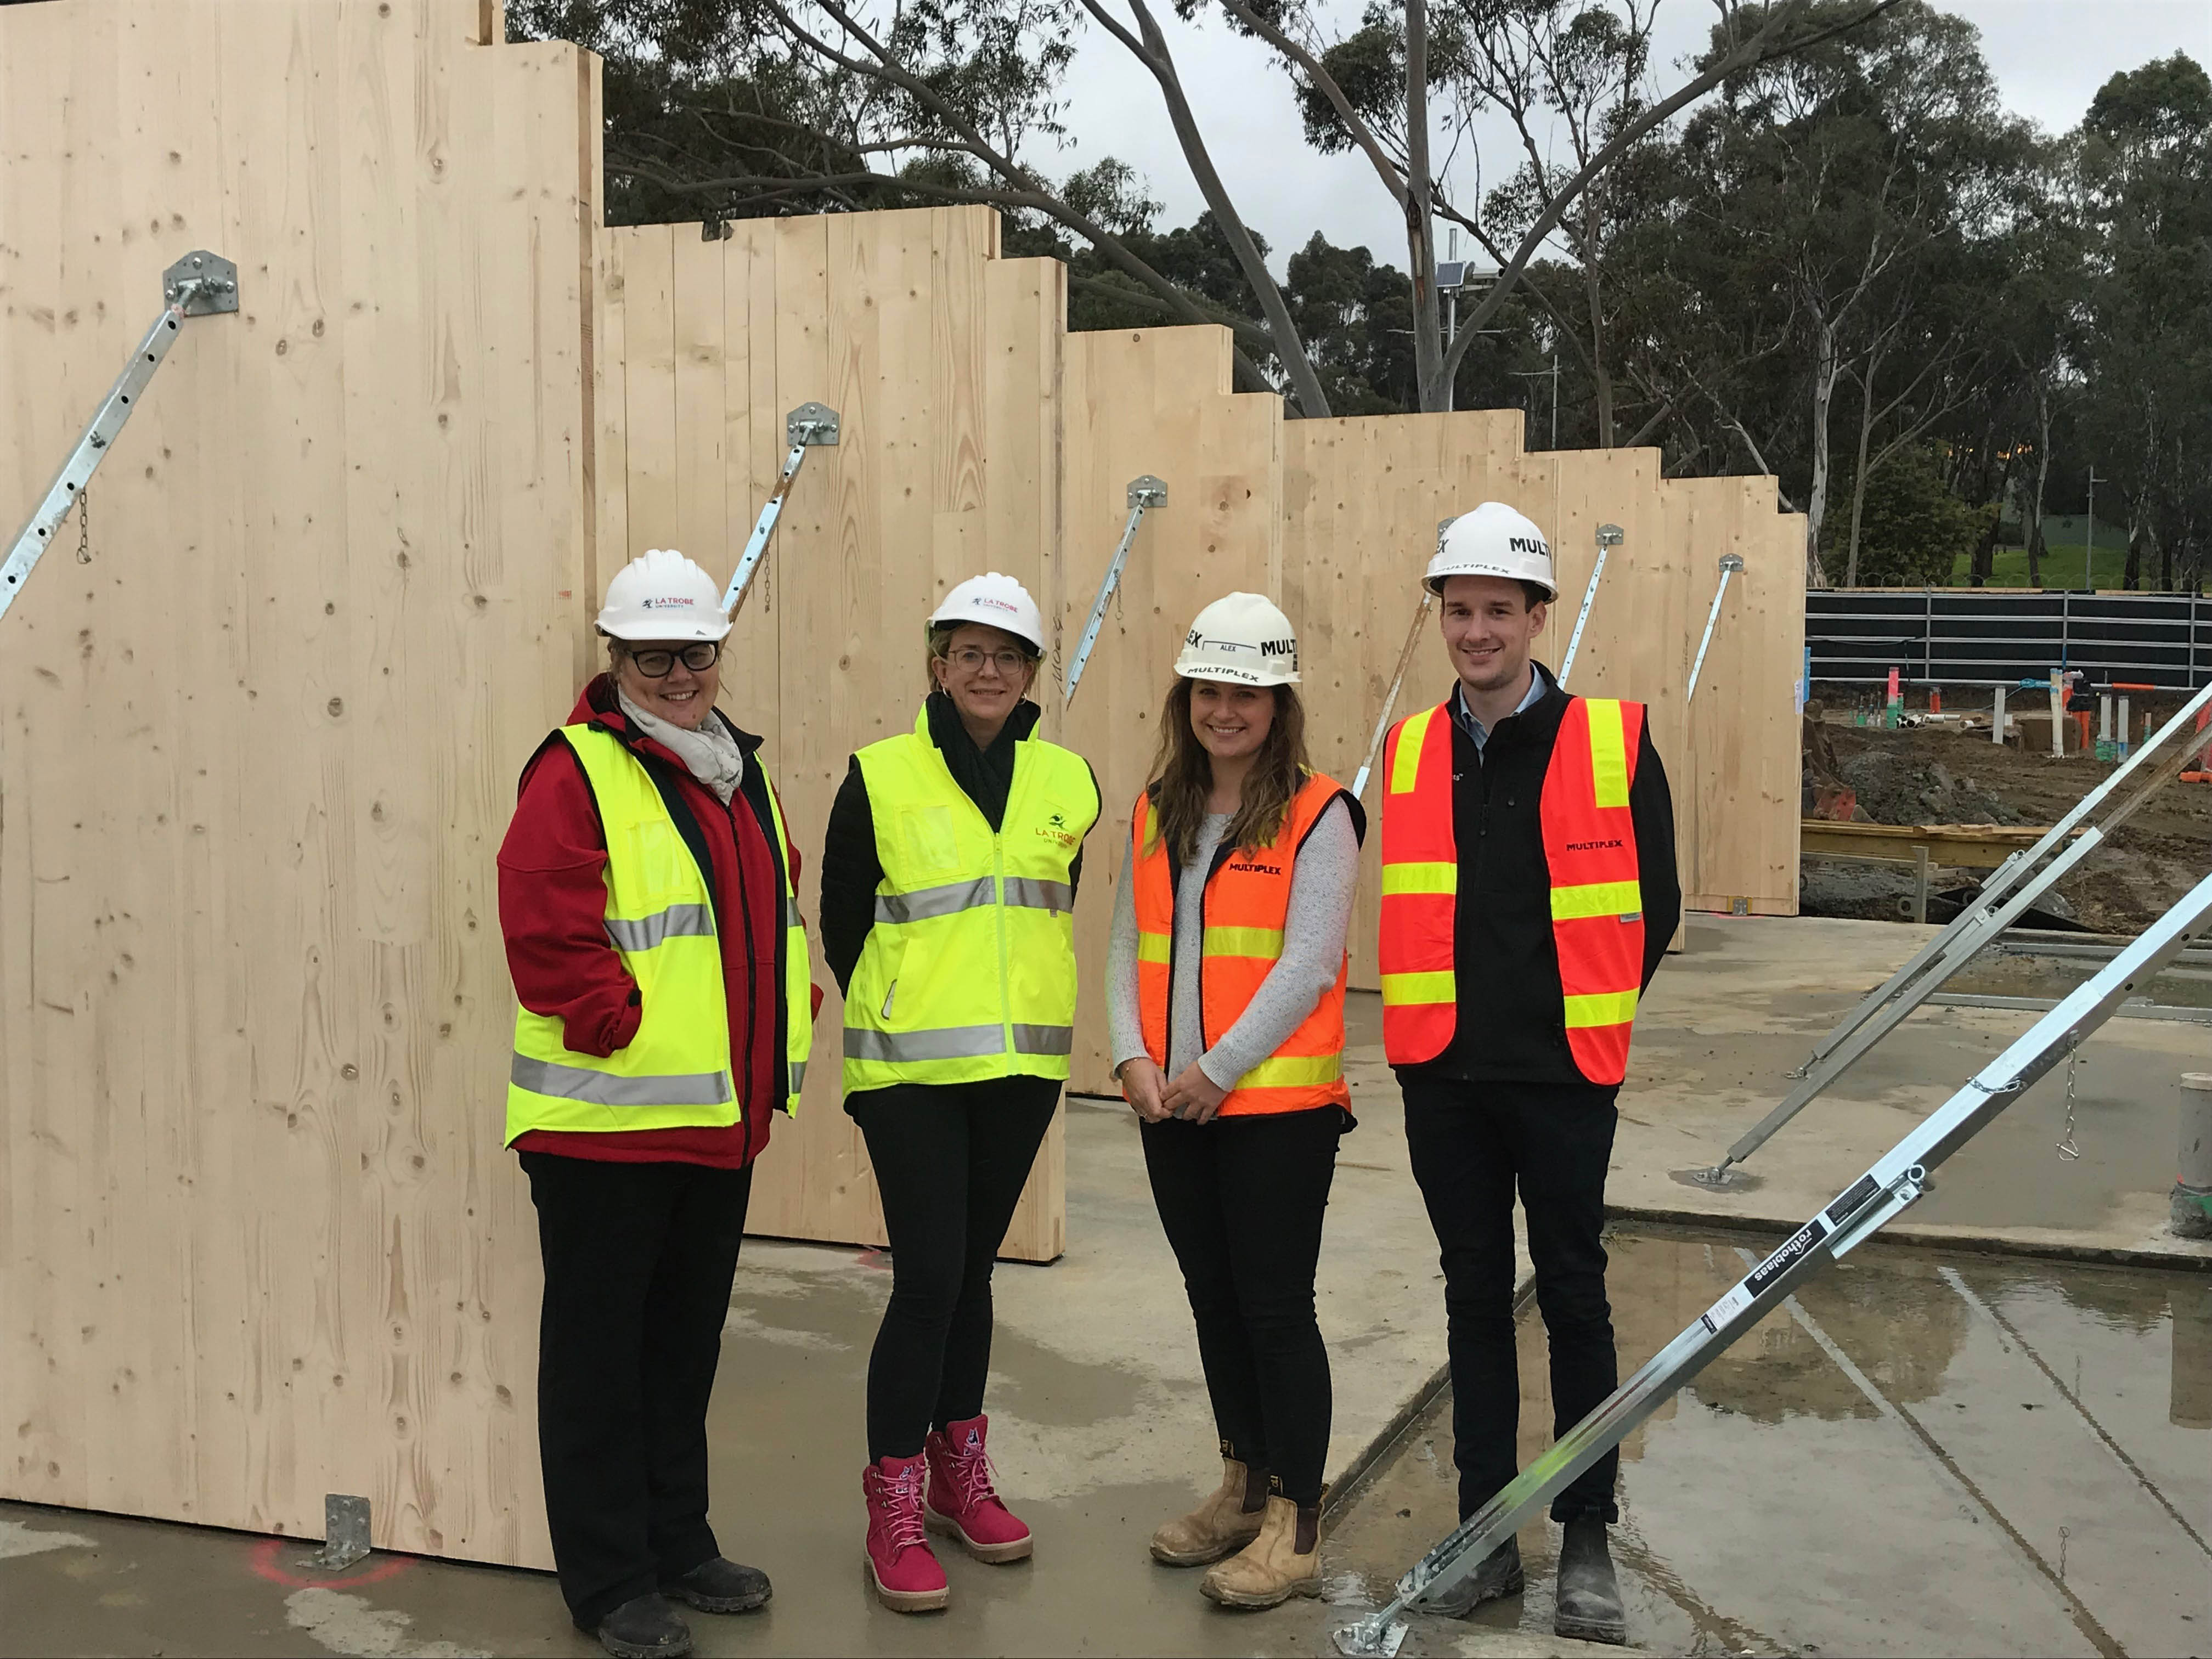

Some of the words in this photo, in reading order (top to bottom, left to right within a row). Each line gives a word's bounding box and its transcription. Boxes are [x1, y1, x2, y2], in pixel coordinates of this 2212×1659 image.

[668, 597, 694, 606] TROBE
[996, 600, 1018, 613] TROBE
[1220, 644, 1237, 652] ALEX
[1187, 667, 1260, 682] MULTIPLEX
[1035, 827, 1049, 837] LA
[1566, 839, 1623, 851] MULTIPLEX
[1228, 863, 1282, 876] MULTIPLEX
[1754, 1229, 1812, 1281] rothoblaas
